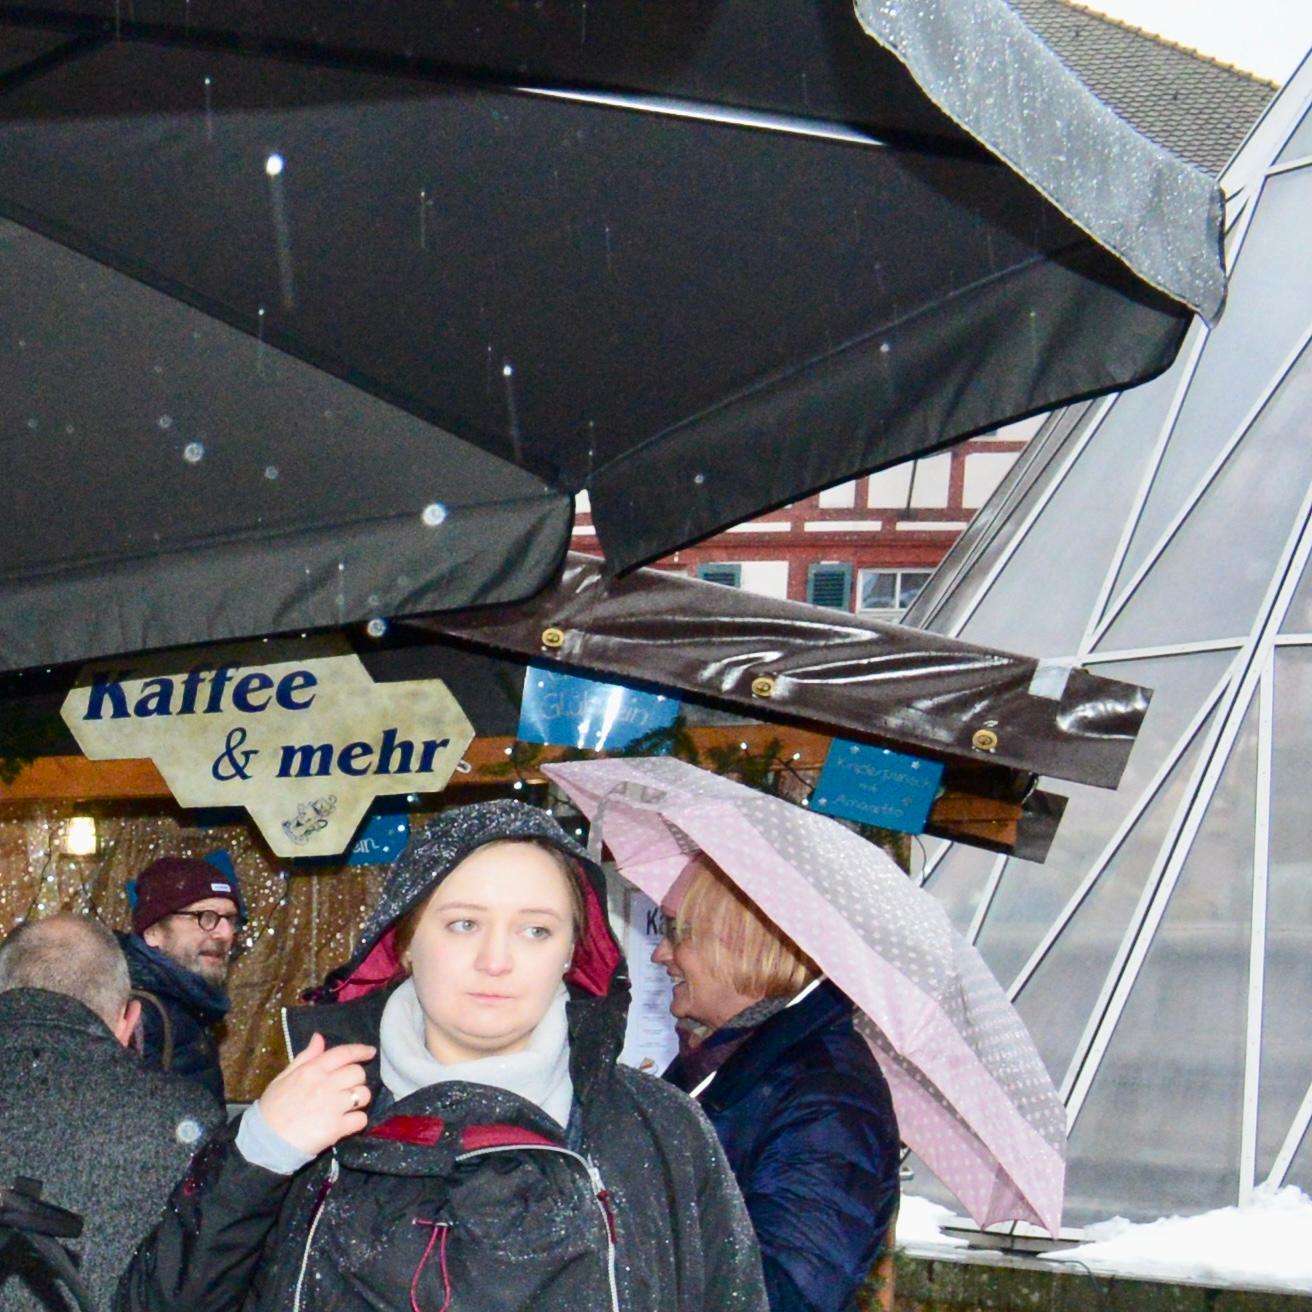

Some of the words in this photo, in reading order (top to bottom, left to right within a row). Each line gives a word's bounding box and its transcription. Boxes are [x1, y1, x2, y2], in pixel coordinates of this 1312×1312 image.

[82, 661, 318, 721] Kaffee
[211, 726, 259, 782] &
[275, 727, 450, 779] mehr
